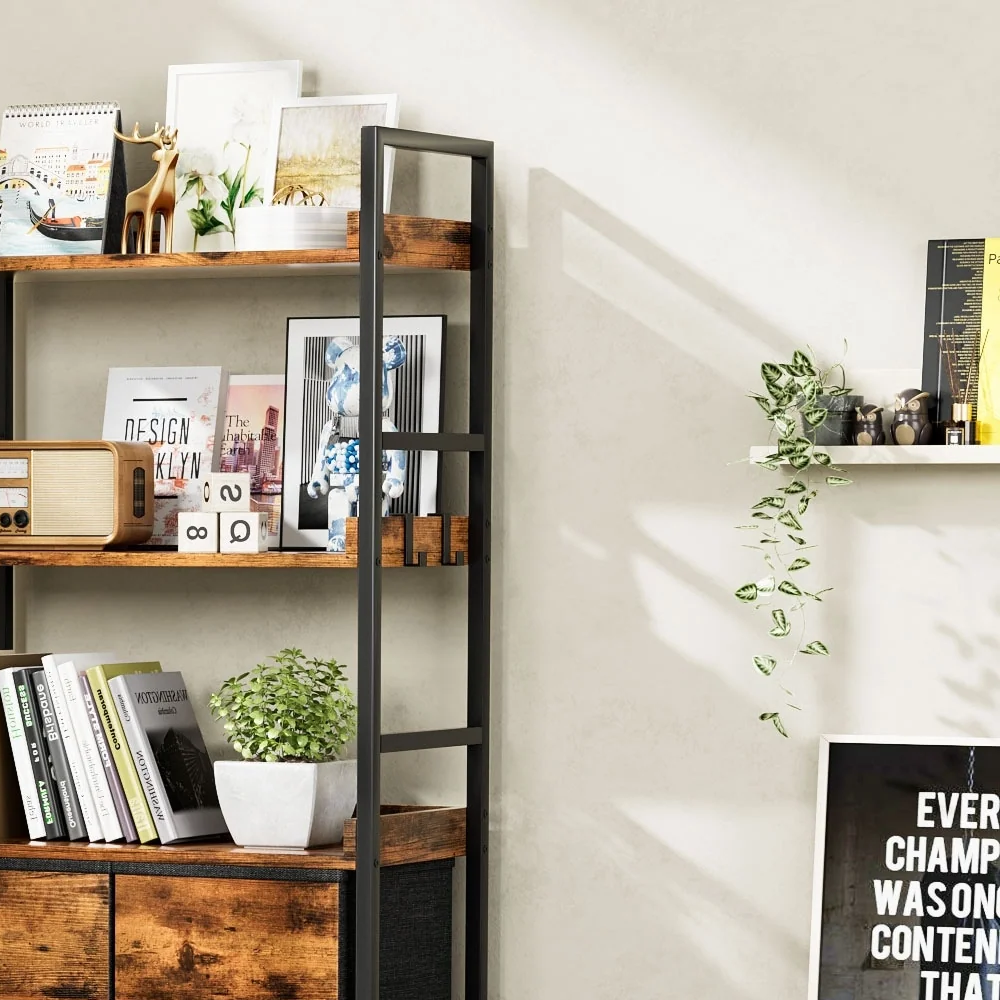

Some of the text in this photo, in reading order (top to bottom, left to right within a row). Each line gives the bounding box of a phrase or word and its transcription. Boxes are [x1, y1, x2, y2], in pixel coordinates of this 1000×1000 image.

[19, 120, 51, 128] WORLD
[225, 414, 250, 428] The
[156, 452, 201, 479] KLYN
[186, 525, 208, 540] 8
[917, 791, 1000, 830] EVER
[884, 835, 1000, 875] CHAMP
[873, 879, 1000, 920] WAS ON
